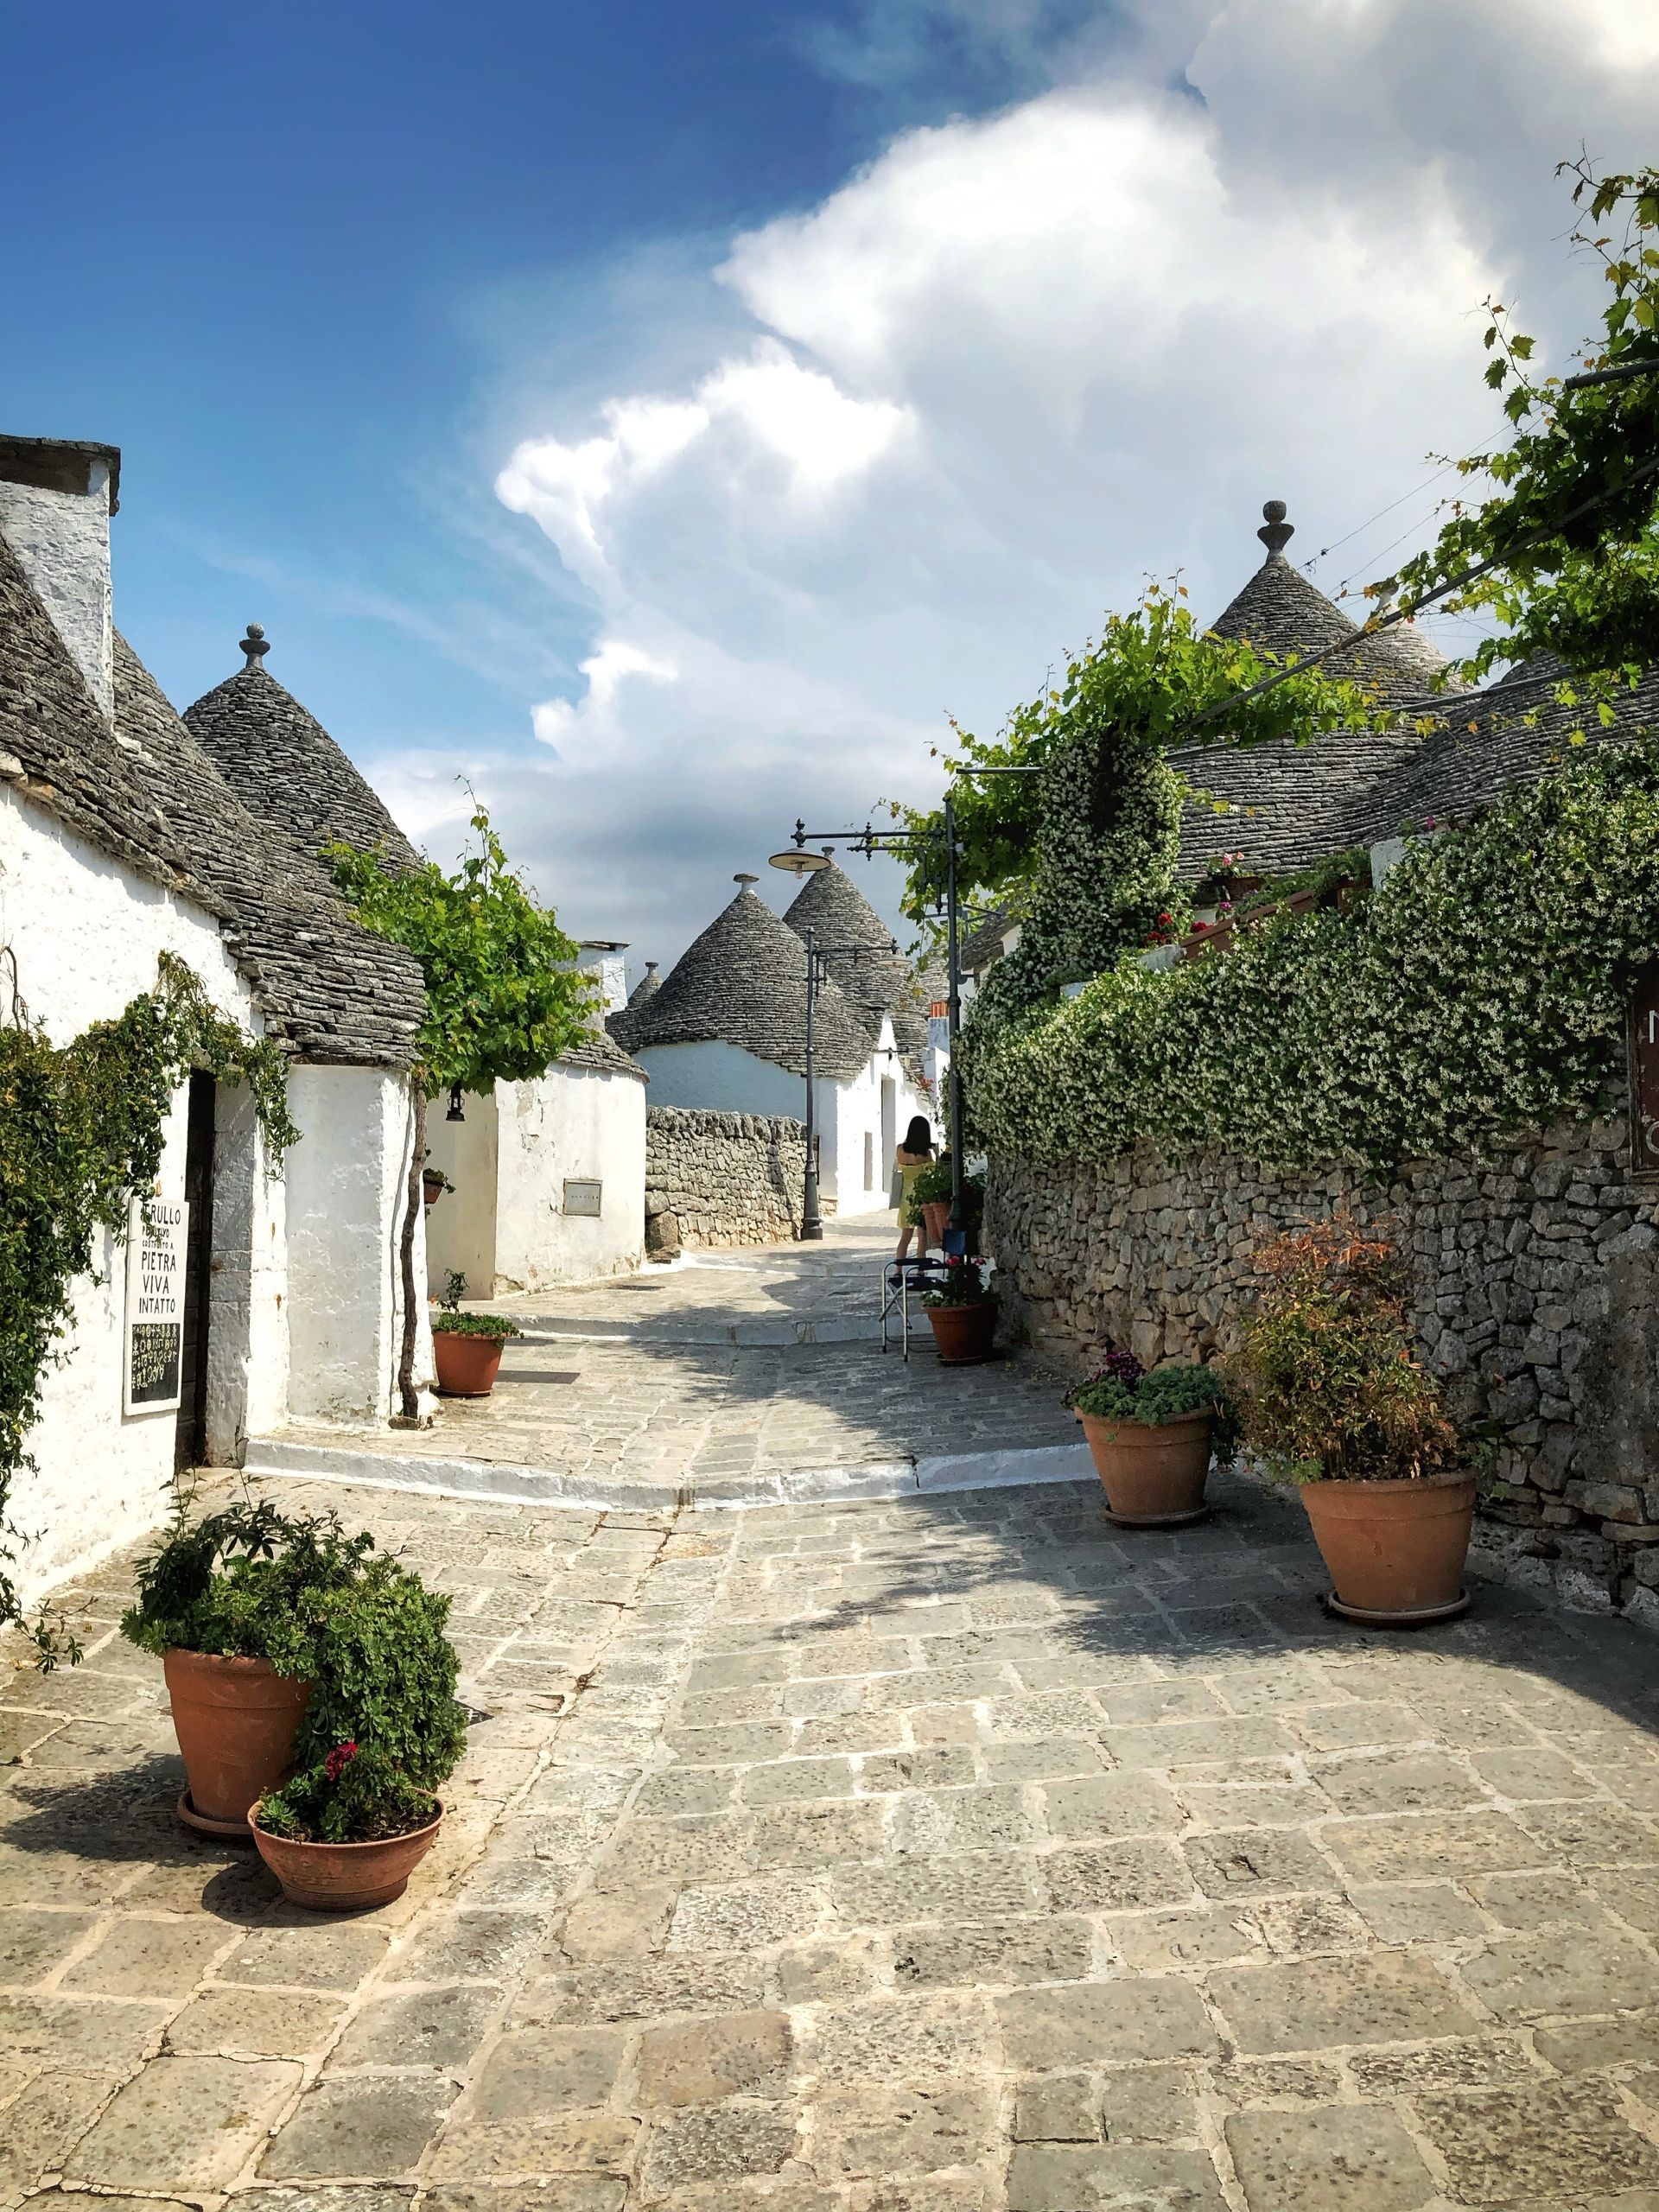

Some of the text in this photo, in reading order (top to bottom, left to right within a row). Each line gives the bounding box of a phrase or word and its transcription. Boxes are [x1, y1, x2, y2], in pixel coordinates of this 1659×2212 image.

[143, 1204, 181, 1225] TRULLO
[142, 1251, 176, 1272] PIETRA
[143, 1274, 169, 1294] VIVA
[139, 1297, 175, 1314] INTATTO
